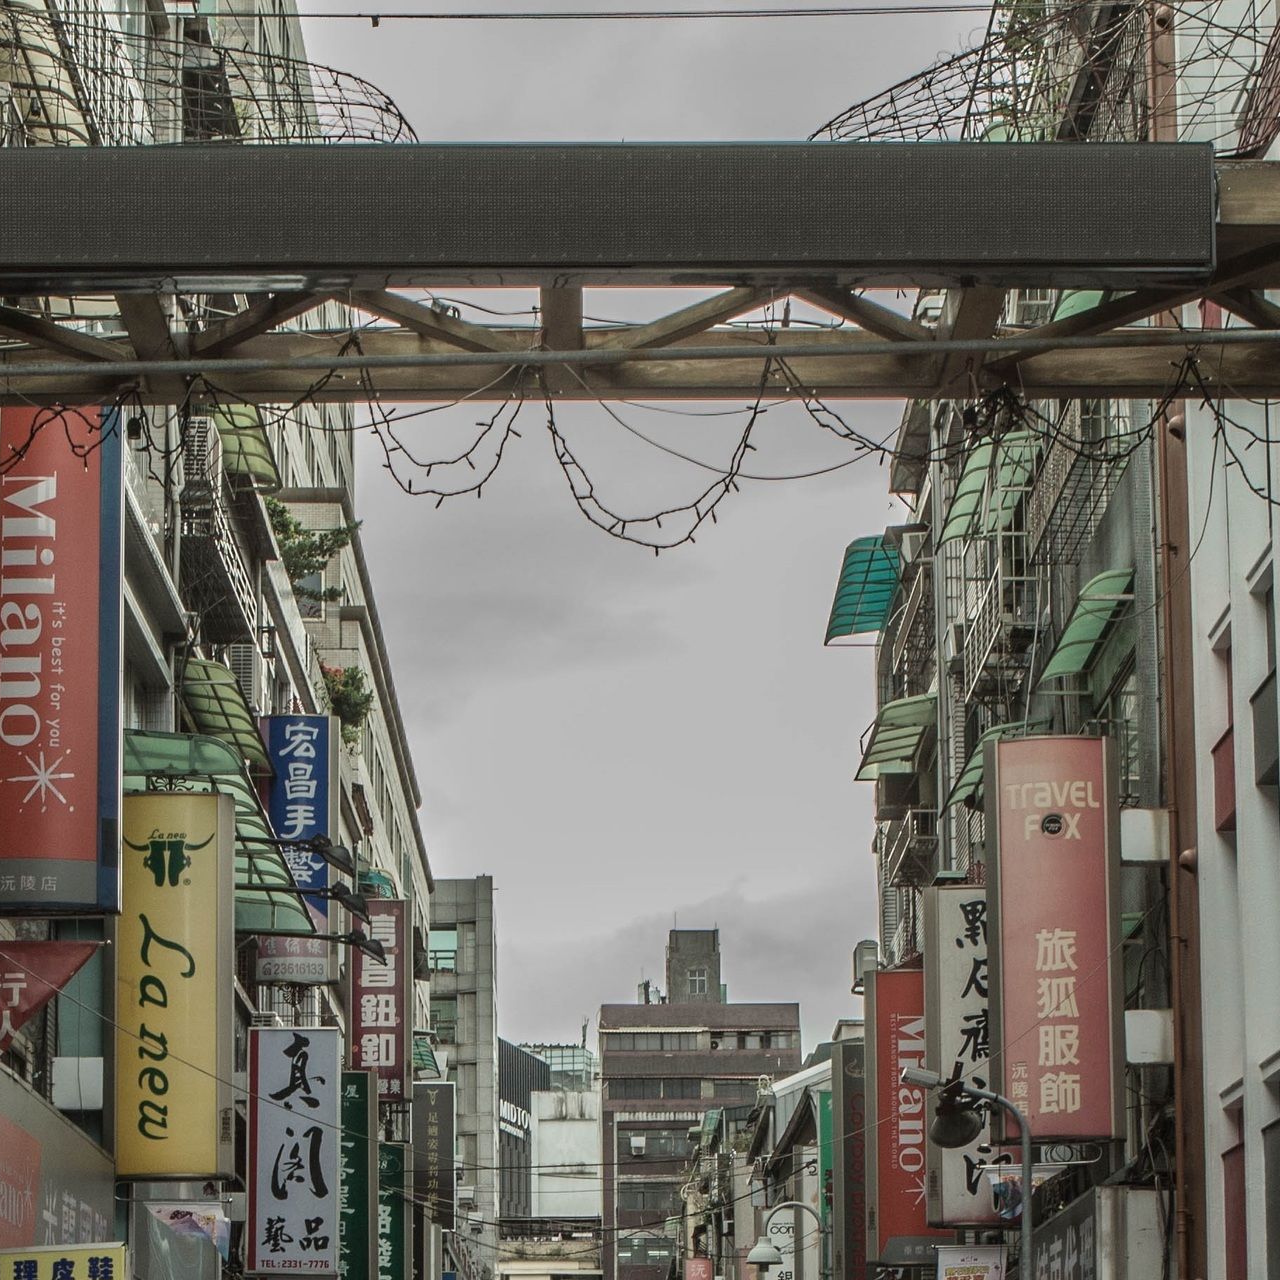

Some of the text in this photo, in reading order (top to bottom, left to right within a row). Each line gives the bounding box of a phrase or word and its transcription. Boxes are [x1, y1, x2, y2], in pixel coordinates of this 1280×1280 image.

[45, 601, 67, 748] it's best for you
[0, 874, 58, 893] 沅陵店
[136, 913, 196, 1142] La new
[897, 1013, 927, 1173] Miano
[1035, 928, 1082, 1114] 旅狐服飾
